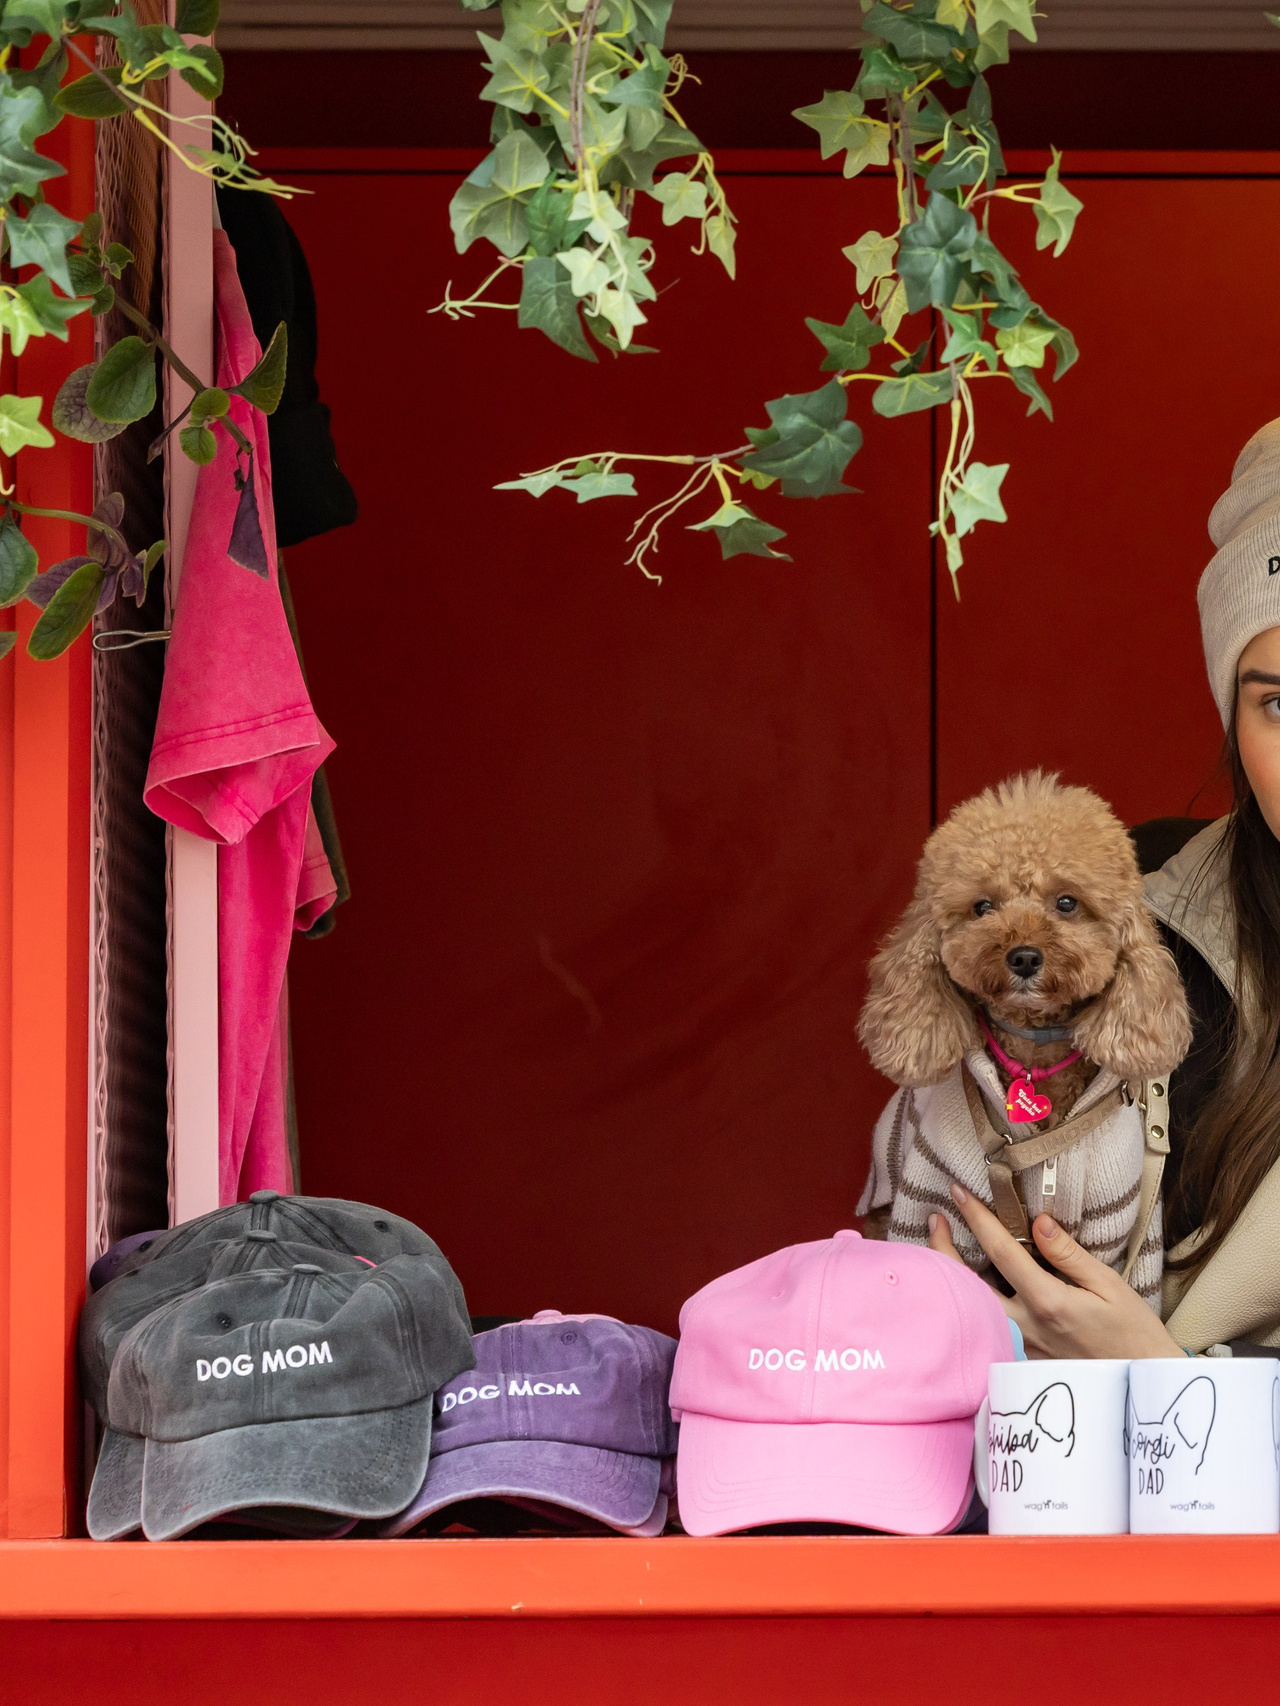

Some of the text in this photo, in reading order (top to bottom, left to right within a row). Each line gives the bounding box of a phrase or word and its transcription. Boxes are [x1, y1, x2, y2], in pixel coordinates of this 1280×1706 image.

[1015, 1098, 1035, 1116] psycho
[196, 1340, 333, 1383] DOG MOM
[748, 1348, 886, 1372] DOG MOM
[441, 1379, 581, 1413] DOG MOM
[992, 1459, 1023, 1492] DAD
[1139, 1468, 1164, 1495] DAD
